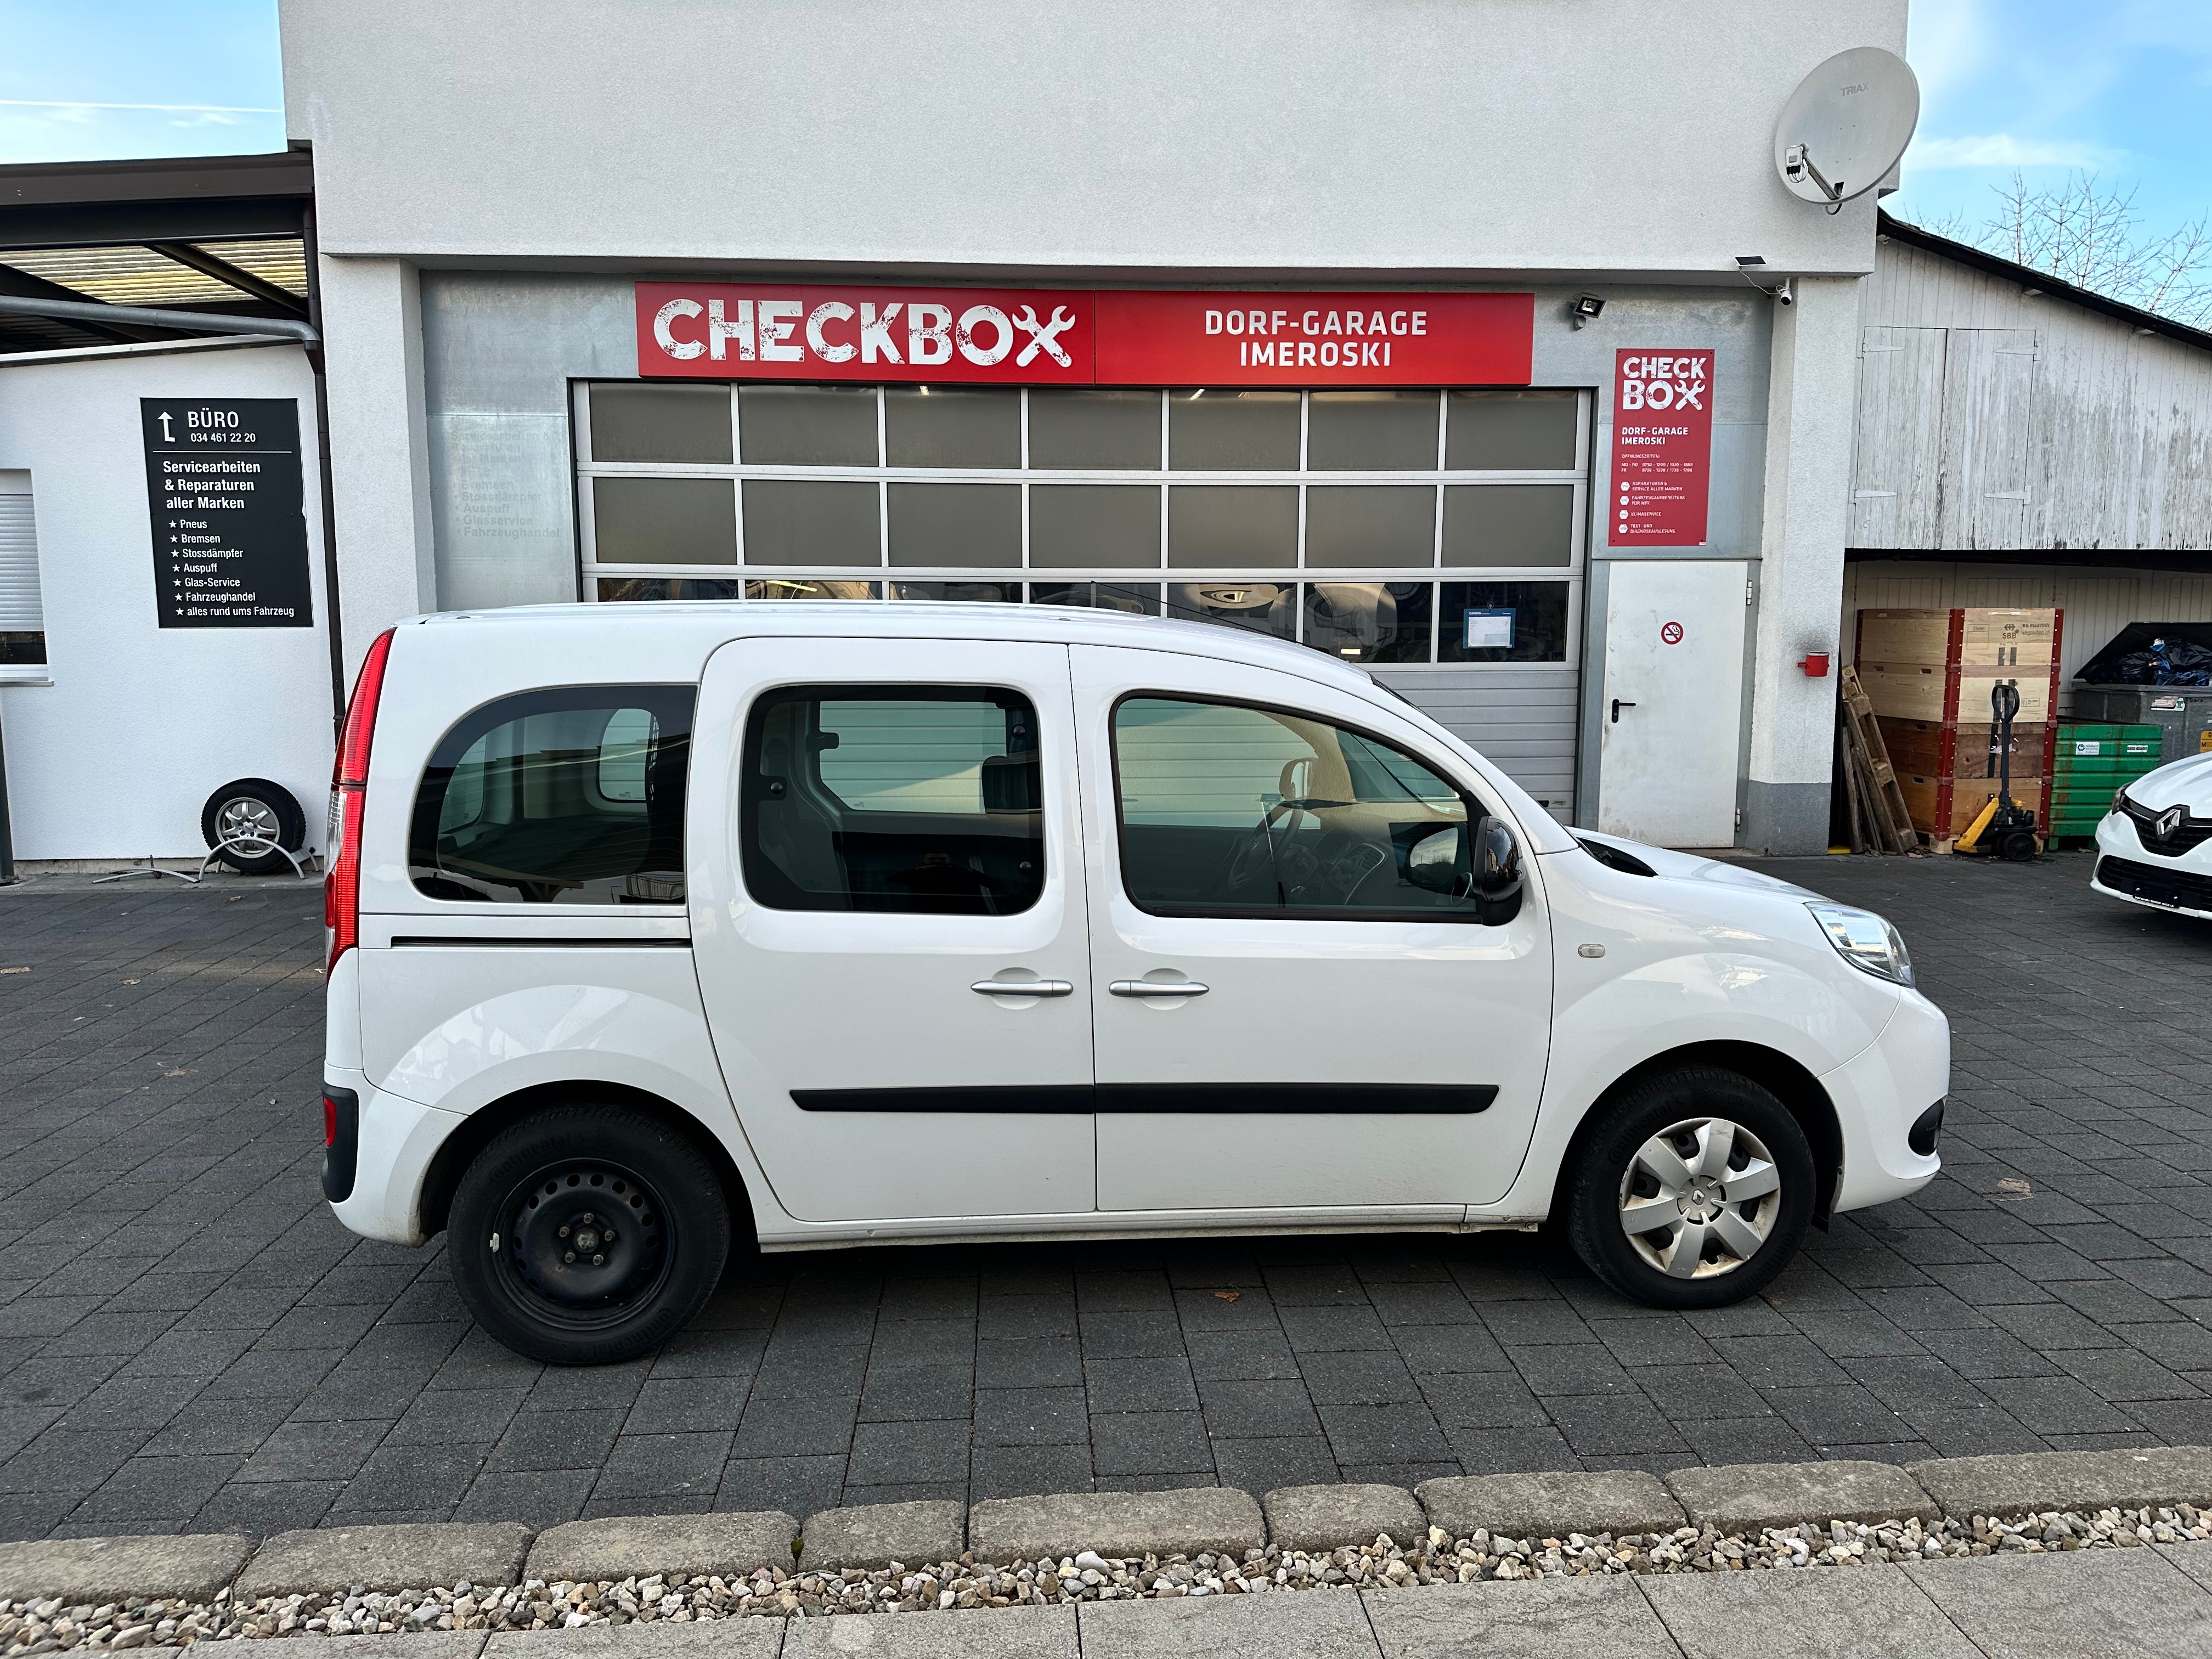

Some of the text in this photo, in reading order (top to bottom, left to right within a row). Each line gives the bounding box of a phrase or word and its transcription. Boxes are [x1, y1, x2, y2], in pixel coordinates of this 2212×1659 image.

[1840, 81, 1869, 97] TRIAX
[1205, 310, 1427, 335] DORF-GARAGE
[1240, 342, 1391, 366] IMEROSKI
[1623, 357, 1707, 379] CHECK
[188, 407, 239, 427] BÜRO
[190, 433, 256, 442] 034 461 22 20
[1622, 437, 1665, 445] IMEROSKI
[163, 461, 261, 473] Servicearbeiten
[165, 479, 255, 493] & Reparaturen
[166, 496, 245, 509] aller Marken
[180, 520, 207, 529] Pneus
[463, 515, 533, 525] Glasservice
[181, 534, 221, 543] Bremsen
[464, 527, 560, 539] Fahrzeughandel
[182, 548, 243, 559] Stossdämpfer
[183, 563, 218, 574] Auspuff
[185, 577, 240, 587] Glas-Service
[186, 592, 256, 603] Fahrzeughandel
[187, 606, 208, 616] alles
[210, 607, 230, 616] rund
[254, 606, 295, 617] Fahrzeug
